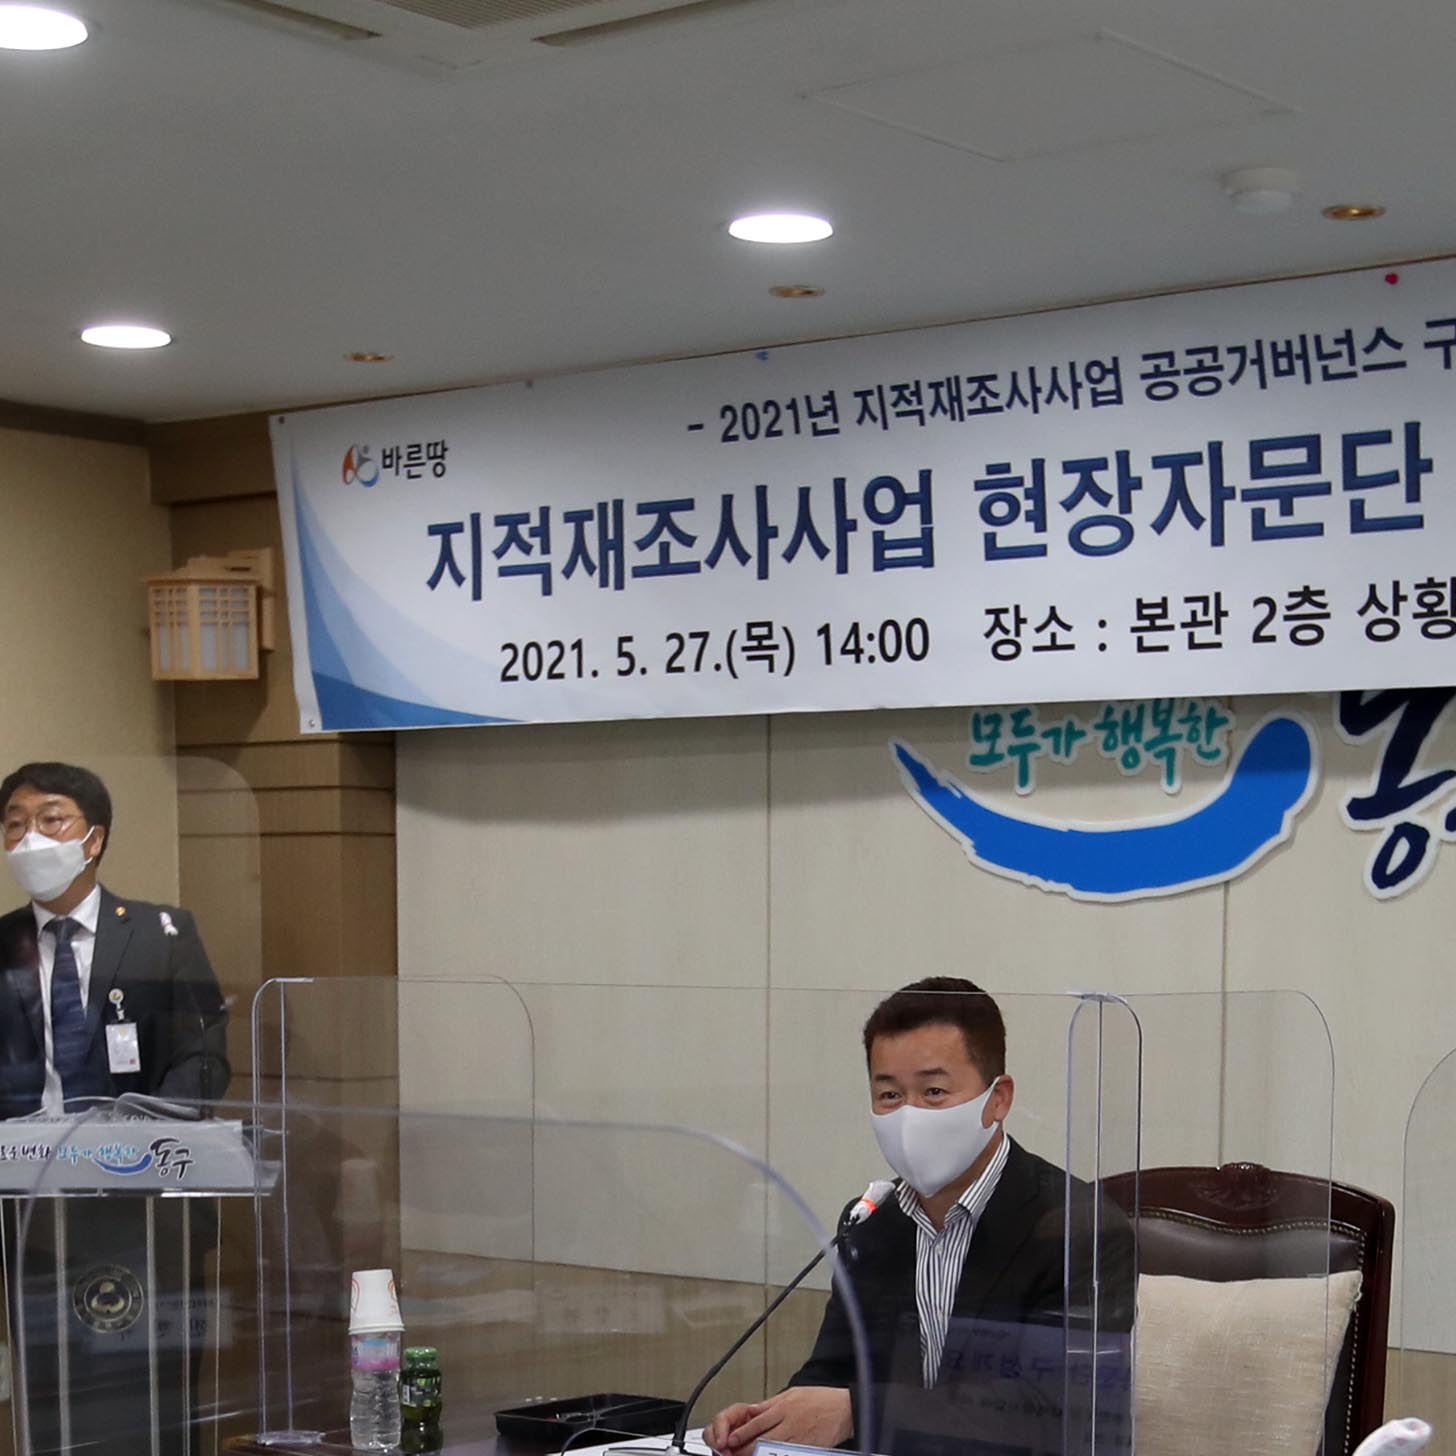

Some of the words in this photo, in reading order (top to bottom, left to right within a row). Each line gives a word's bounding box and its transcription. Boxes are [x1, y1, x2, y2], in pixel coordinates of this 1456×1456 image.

[719, 389, 841, 443] 2021년
[853, 355, 1125, 431] 지적재조사사업
[1139, 325, 1408, 401] 공공거버넌스
[380, 439, 450, 480] 바른땅
[425, 467, 936, 602] 지적재조사사업
[973, 420, 1434, 562] 현장자문단
[498, 637, 600, 683] 2021.
[615, 634, 649, 678] 5.
[664, 620, 796, 679] 27.(목)
[816, 617, 931, 667] 14:00
[982, 602, 1077, 662] 장소
[1129, 590, 1230, 655] 본관
[1250, 585, 1333, 648] 2층
[1093, 697, 1230, 787] 행복한
[149, 1137, 194, 1179] 동구
